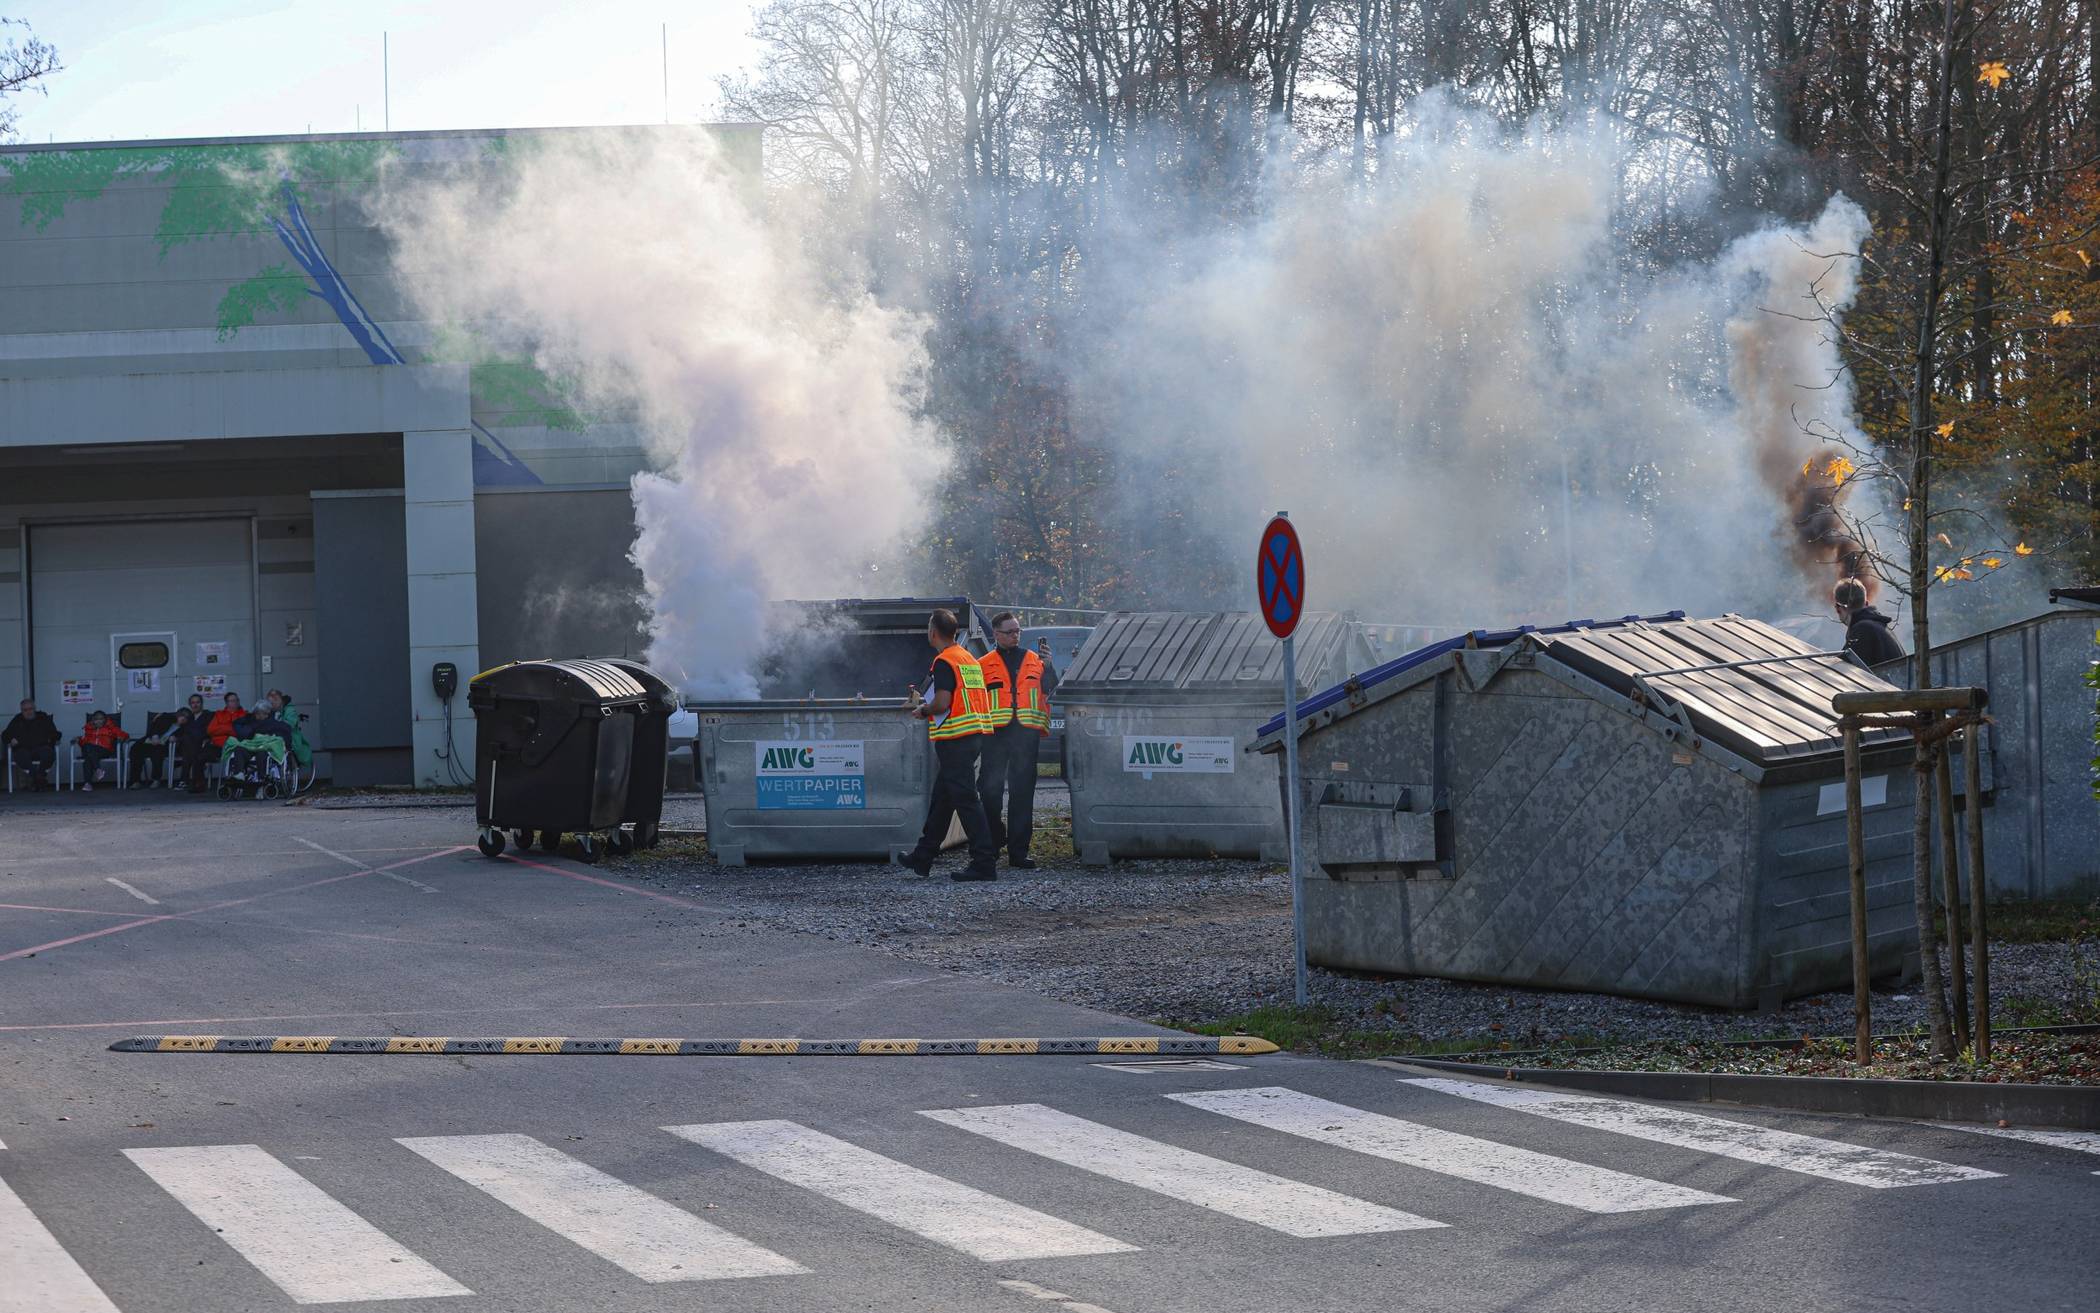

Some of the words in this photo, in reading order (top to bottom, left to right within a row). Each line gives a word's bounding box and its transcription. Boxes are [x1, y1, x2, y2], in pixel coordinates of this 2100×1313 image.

[784, 712, 835, 741] 513
[761, 748, 815, 769] AWG
[1129, 743, 1184, 765] AWG
[759, 779, 861, 792] WERTPAPIER
[836, 794, 862, 805] AWG
